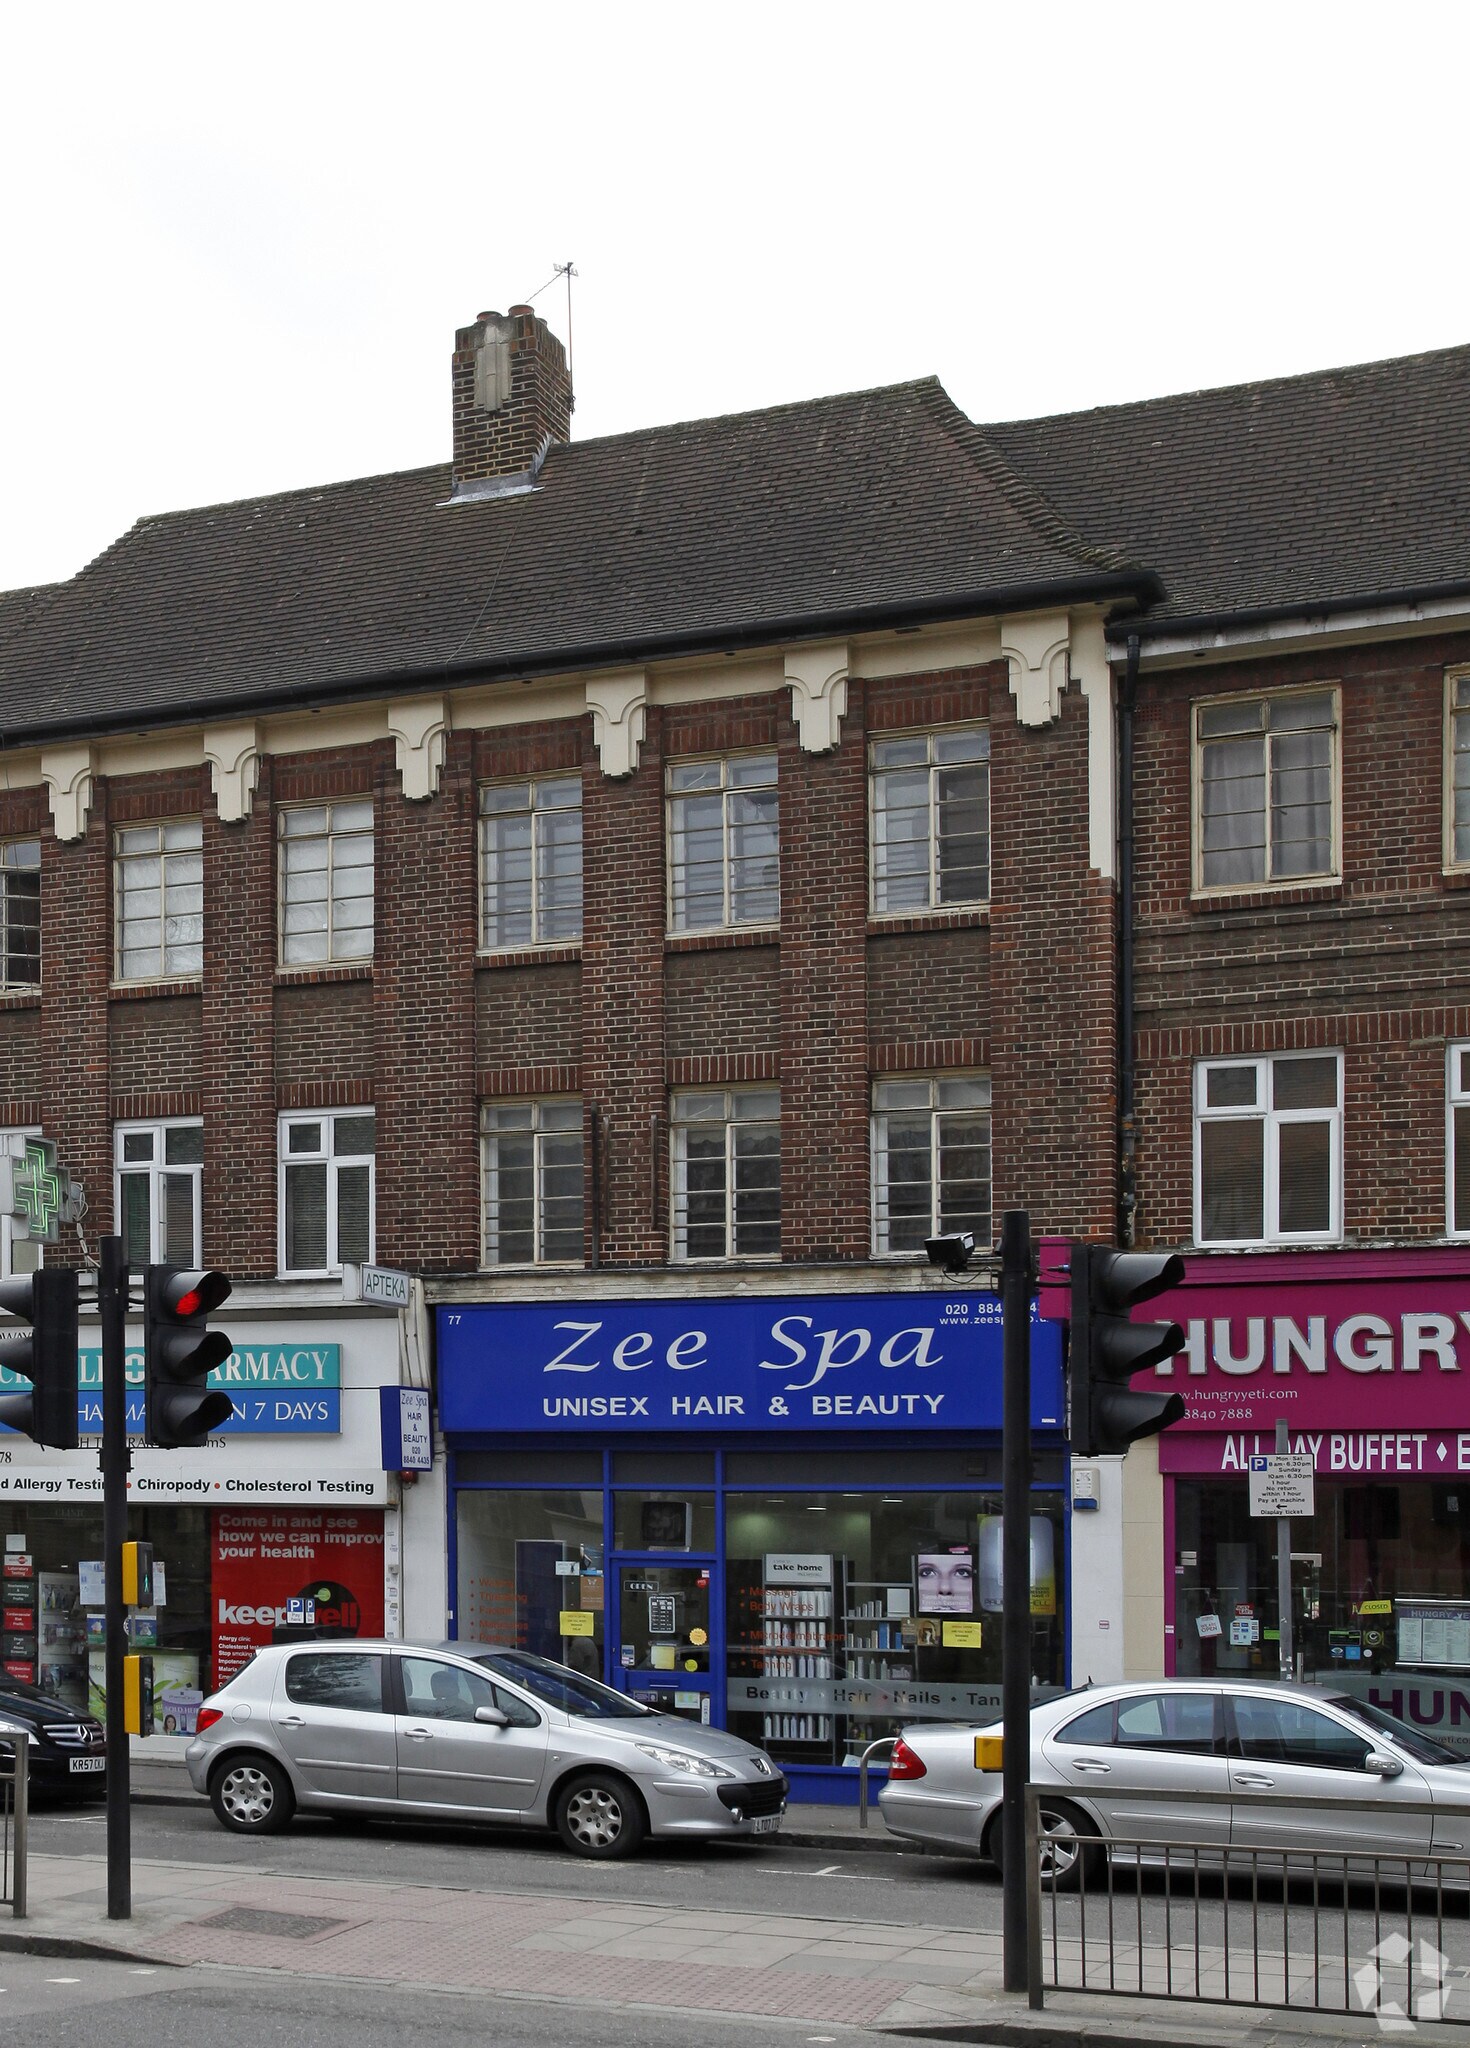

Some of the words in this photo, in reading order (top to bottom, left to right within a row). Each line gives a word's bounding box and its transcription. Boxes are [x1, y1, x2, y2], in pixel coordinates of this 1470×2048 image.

[365, 1273, 406, 1299] APTEKA
[945, 1304, 968, 1315] 020
[978, 1303, 1003, 1314] 884
[448, 1315, 461, 1325] 77
[1154, 1311, 1470, 1376] HUNGR
[543, 1320, 708, 1373] Zee
[758, 1316, 943, 1391] Spa
[401, 1394, 413, 1405] Zee
[1180, 1389, 1298, 1403] w.hungryyeti.com
[255, 1403, 269, 1420] 7
[275, 1402, 329, 1421] DAYS
[543, 1396, 649, 1417] UNISEX
[672, 1395, 744, 1415] HAIR
[768, 1396, 789, 1416] &
[812, 1394, 945, 1416] BEAUTY
[408, 1412, 422, 1421] HAIR
[1220, 1408, 1253, 1421] 7888
[403, 1434, 428, 1443] BEAUTY
[1330, 1434, 1428, 1470] BUFFET
[1254, 1459, 1264, 1470] P
[13, 1479, 62, 1492] Allergy
[67, 1479, 104, 1490] Testi
[137, 1478, 211, 1494] Chiropody
[225, 1479, 312, 1492] Cholesterol
[317, 1480, 375, 1496] Testing
[219, 1514, 267, 1527] Come
[272, 1515, 287, 1527] in
[290, 1515, 322, 1528] and
[327, 1517, 358, 1528] see
[219, 1530, 254, 1542] how
[260, 1533, 285, 1543] we
[288, 1533, 321, 1543] can
[324, 1531, 384, 1546] improv
[219, 1547, 256, 1560] your
[261, 1546, 314, 1559] health
[290, 1600, 300, 1612] P
[307, 1600, 313, 1612] P
[750, 1601, 776, 1613] Body
[780, 1602, 814, 1613] Wraps
[1411, 1609, 1452, 1618] HUNGRY
[834, 1688, 871, 1702] Hair
[893, 1691, 941, 1704] Nails
